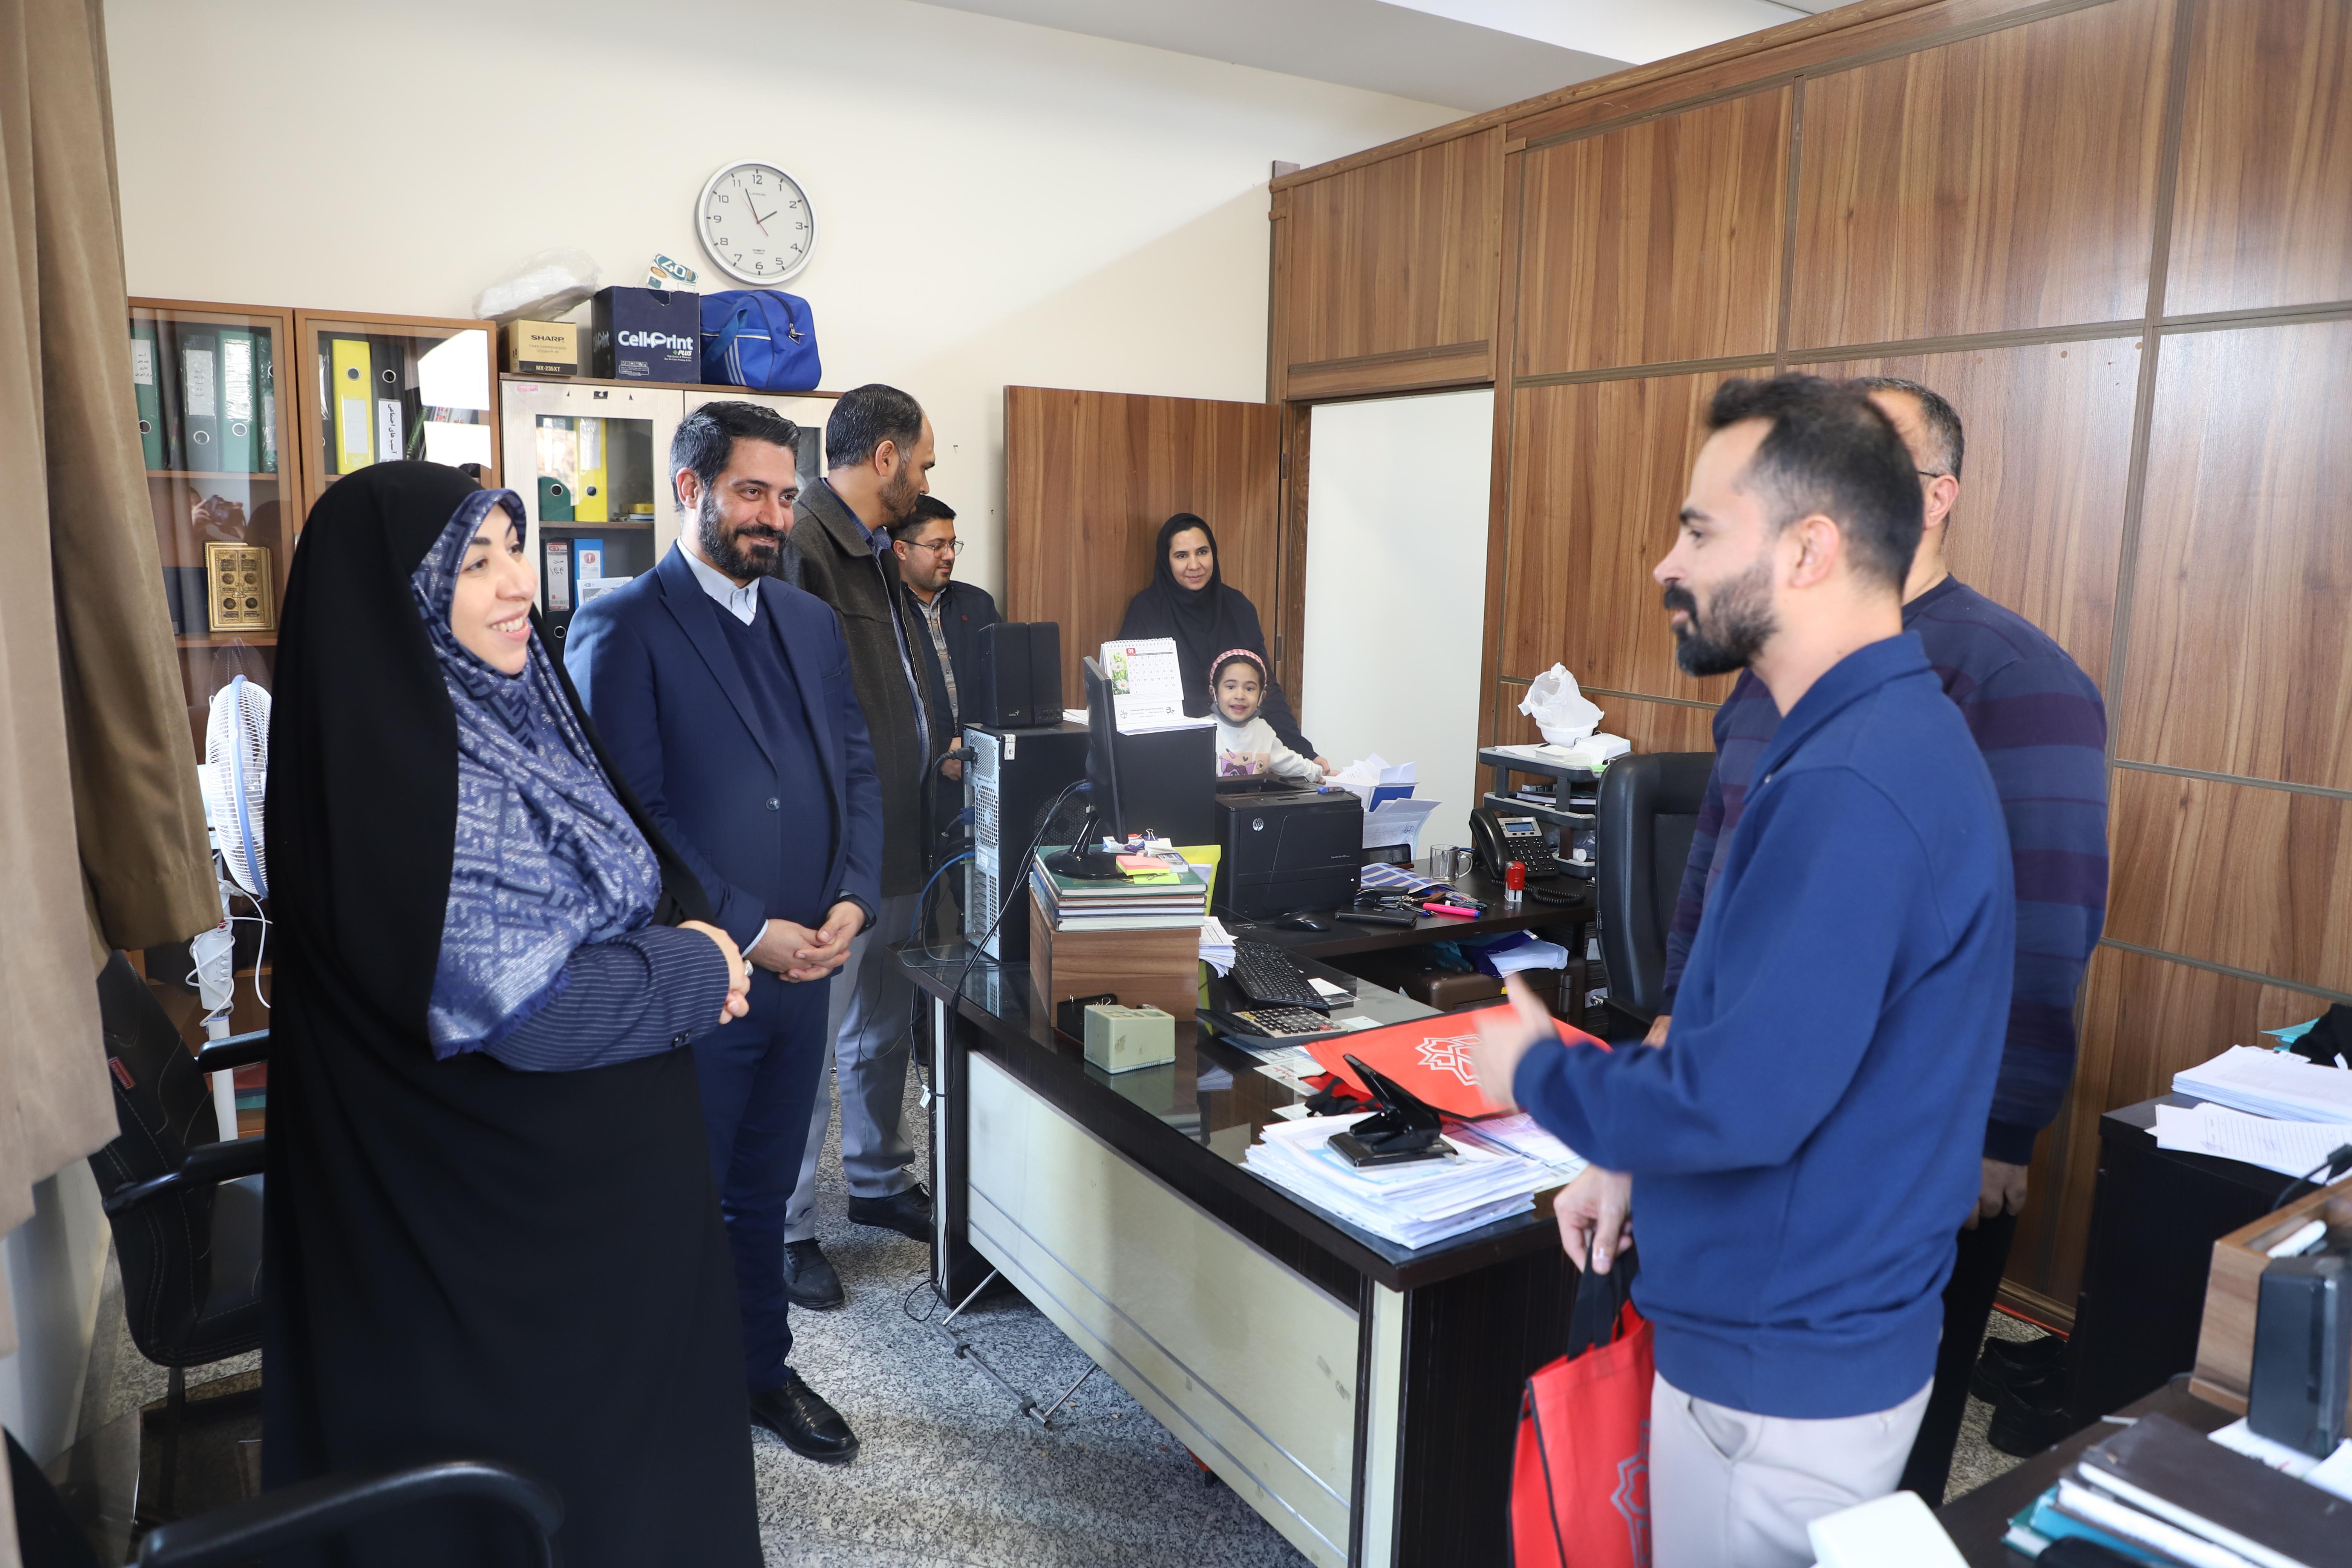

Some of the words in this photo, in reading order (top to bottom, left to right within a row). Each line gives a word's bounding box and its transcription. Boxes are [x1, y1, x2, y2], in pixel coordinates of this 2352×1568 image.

[732, 179, 741, 188] 11
[752, 175, 763, 185] 12
[718, 194, 729, 203] 10
[790, 201, 797, 209] 2
[720, 237, 728, 246] 8
[661, 260, 687, 278] 40
[618, 330, 694, 351] CellPrint
